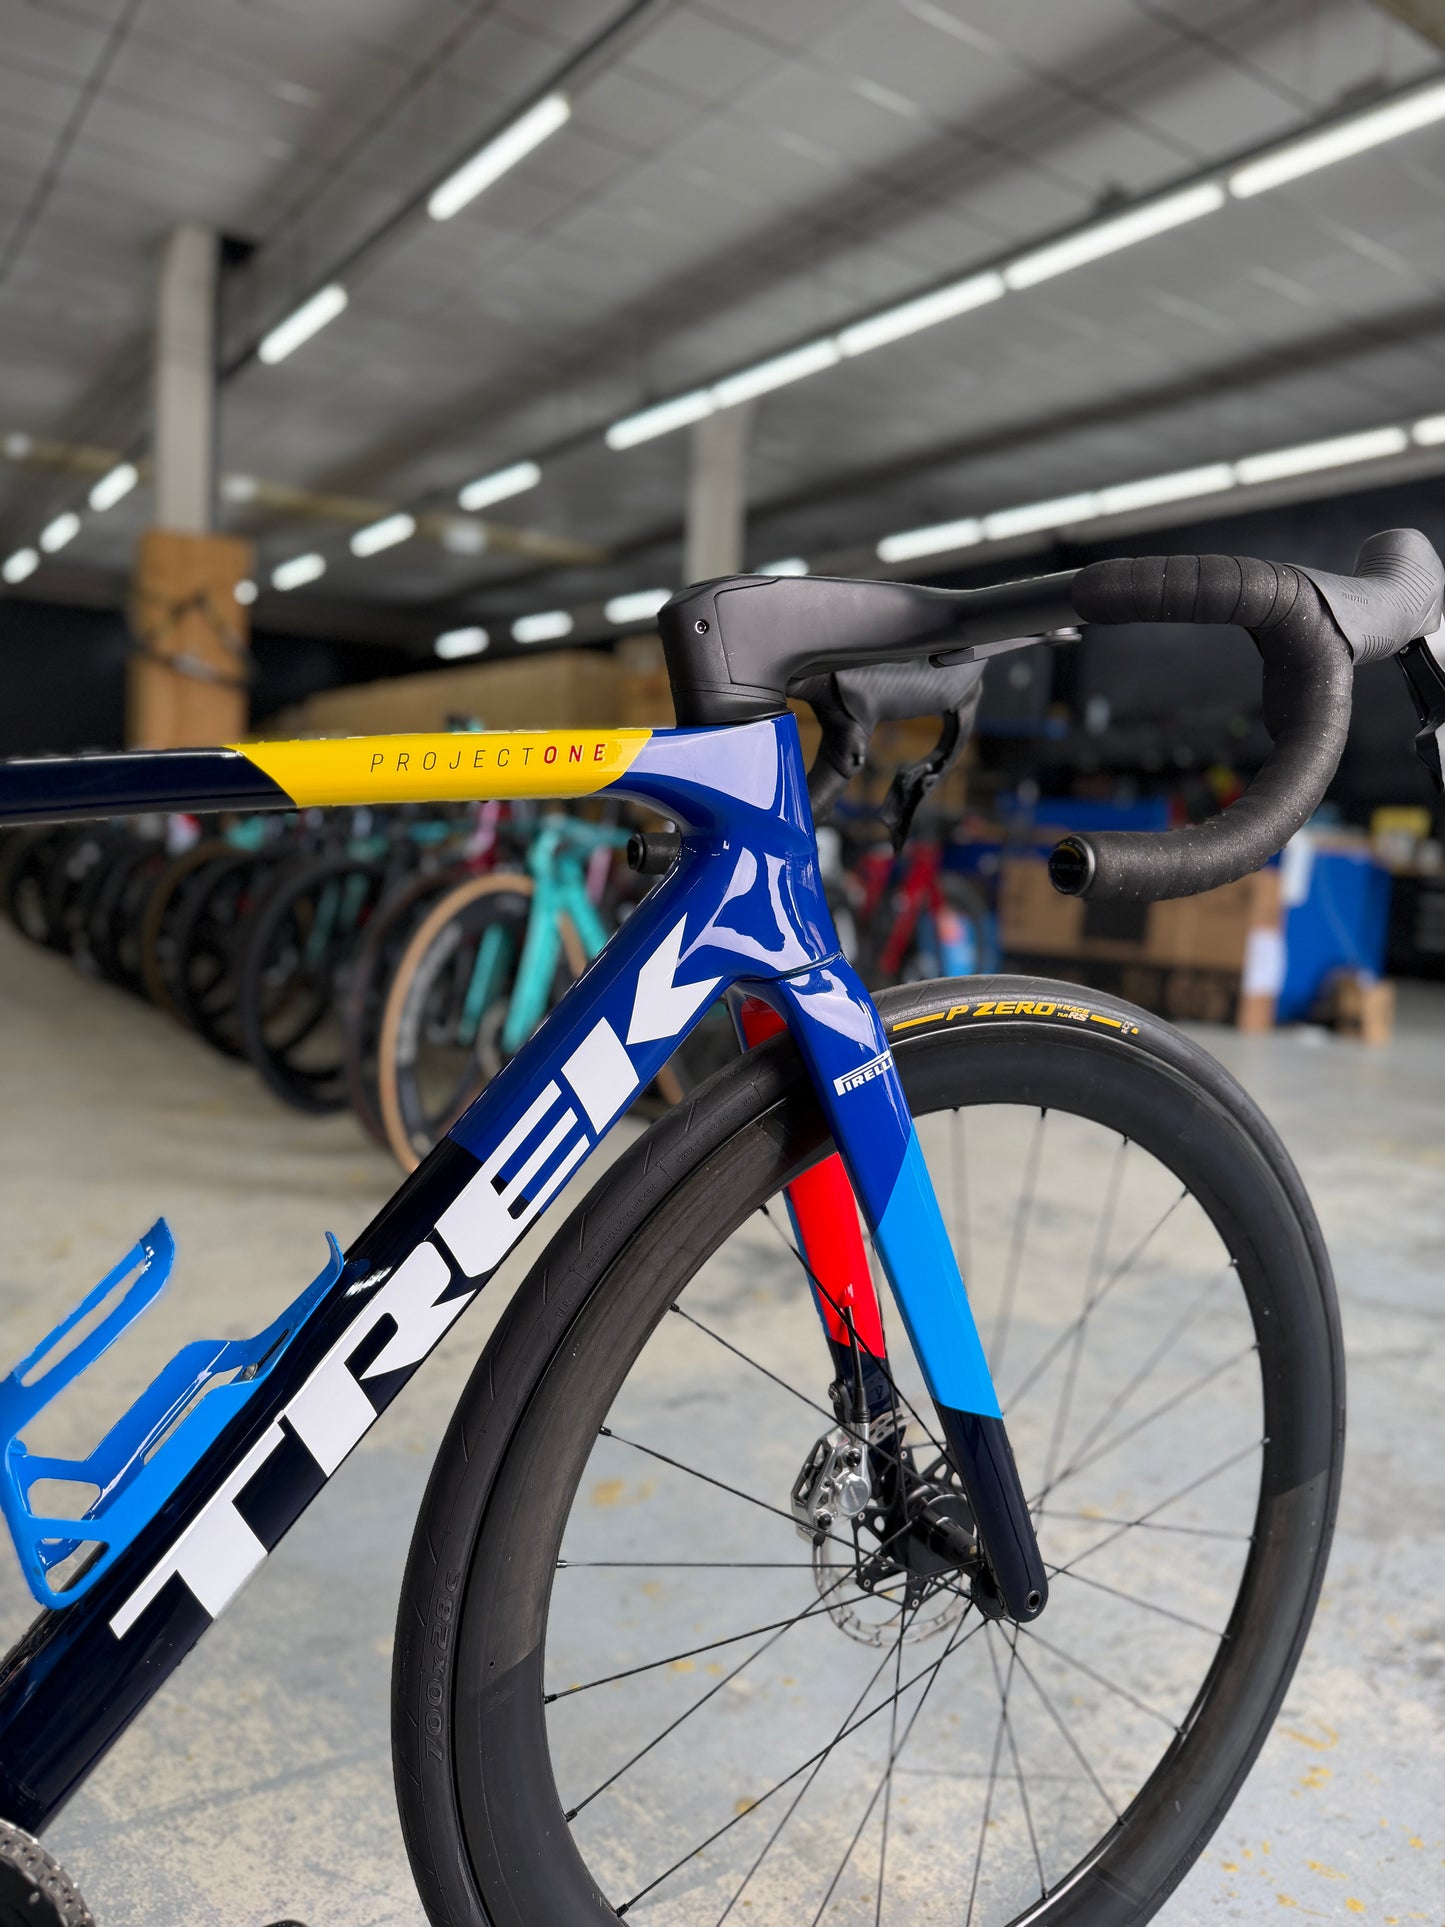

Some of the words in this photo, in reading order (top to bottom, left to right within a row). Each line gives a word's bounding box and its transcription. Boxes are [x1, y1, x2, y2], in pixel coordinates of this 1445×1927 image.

[945, 1004, 970, 1021] P
[972, 1001, 1058, 1016] ZERO
[1068, 1011, 1089, 1021] RS
[833, 1049, 893, 1097] PIRELLI
[109, 912, 723, 1640] TREK
